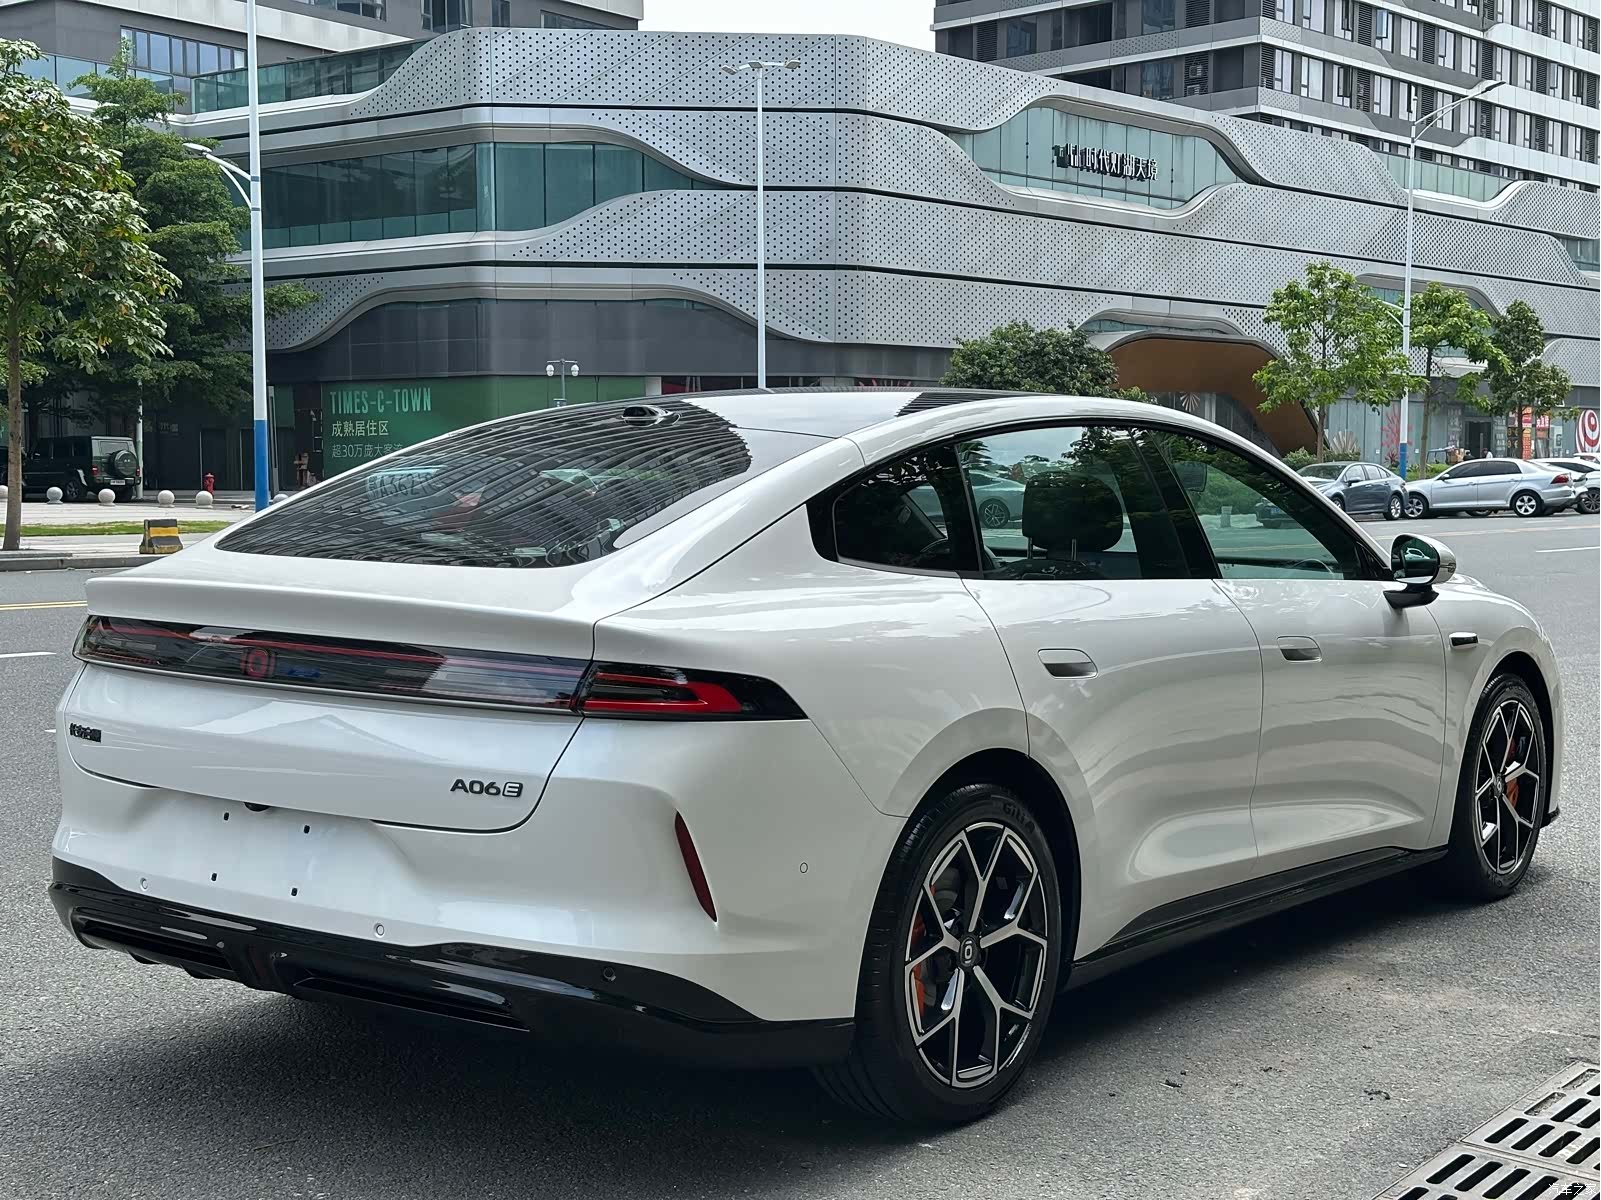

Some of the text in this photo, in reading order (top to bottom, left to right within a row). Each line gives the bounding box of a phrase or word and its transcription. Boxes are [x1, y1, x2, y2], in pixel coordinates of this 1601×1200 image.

[330, 388, 432, 414] TIMES-C-TOWN
[331, 419, 389, 437] 成熟居住区
[450, 778, 523, 798] A06E
